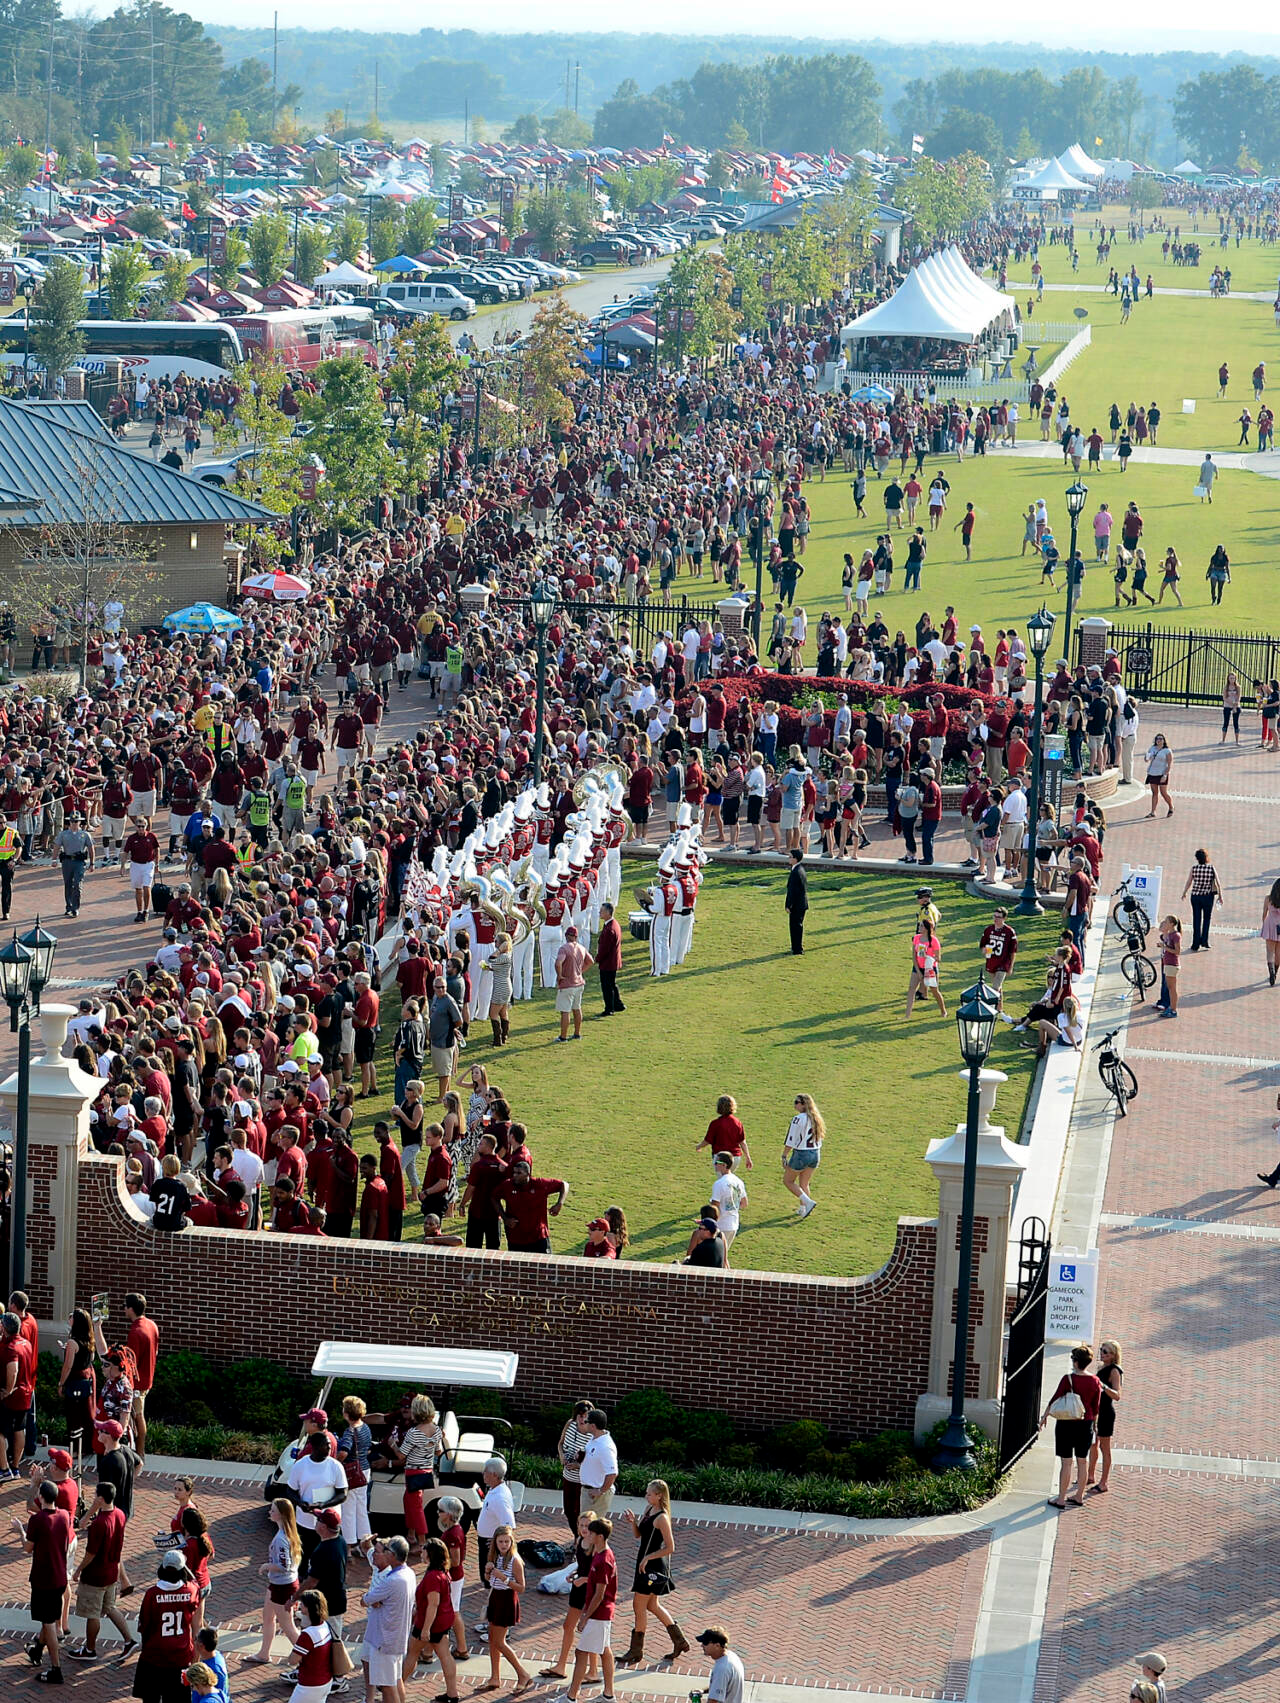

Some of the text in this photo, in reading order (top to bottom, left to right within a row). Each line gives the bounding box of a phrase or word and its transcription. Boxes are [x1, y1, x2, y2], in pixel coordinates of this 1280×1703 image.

[1013, 190, 1041, 198] EXIT
[2, 273, 8, 281] 2
[157, 1194, 175, 1215] 21
[1049, 1286, 1085, 1295] GAMECOCK
[1050, 1313, 1080, 1321] DROP-OFF
[156, 1593, 191, 1603] GAMECOCKS
[161, 1611, 184, 1637] 21
